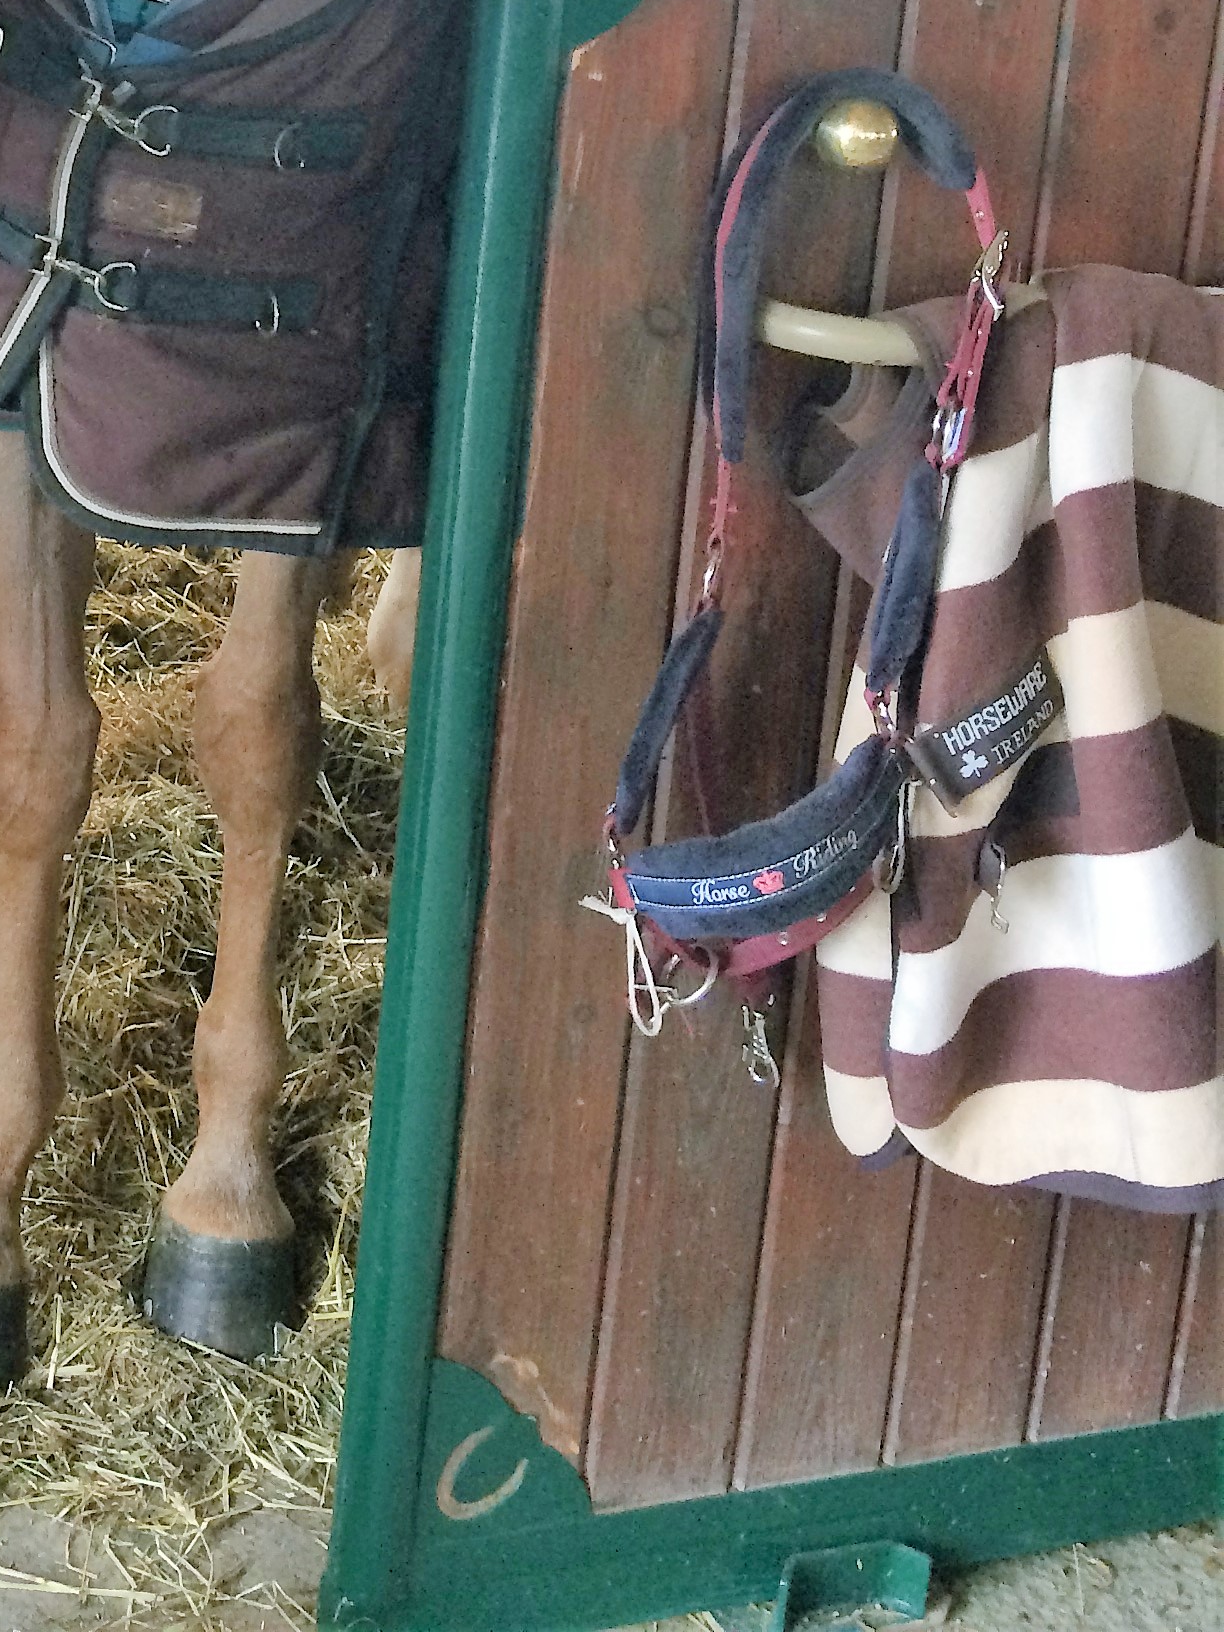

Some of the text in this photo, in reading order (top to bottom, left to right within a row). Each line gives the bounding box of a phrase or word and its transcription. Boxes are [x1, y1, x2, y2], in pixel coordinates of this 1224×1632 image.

[941, 661, 1048, 756] HORSEWARE
[991, 699, 1054, 765] IRELAND
[691, 829, 858, 905] Horse Riding
